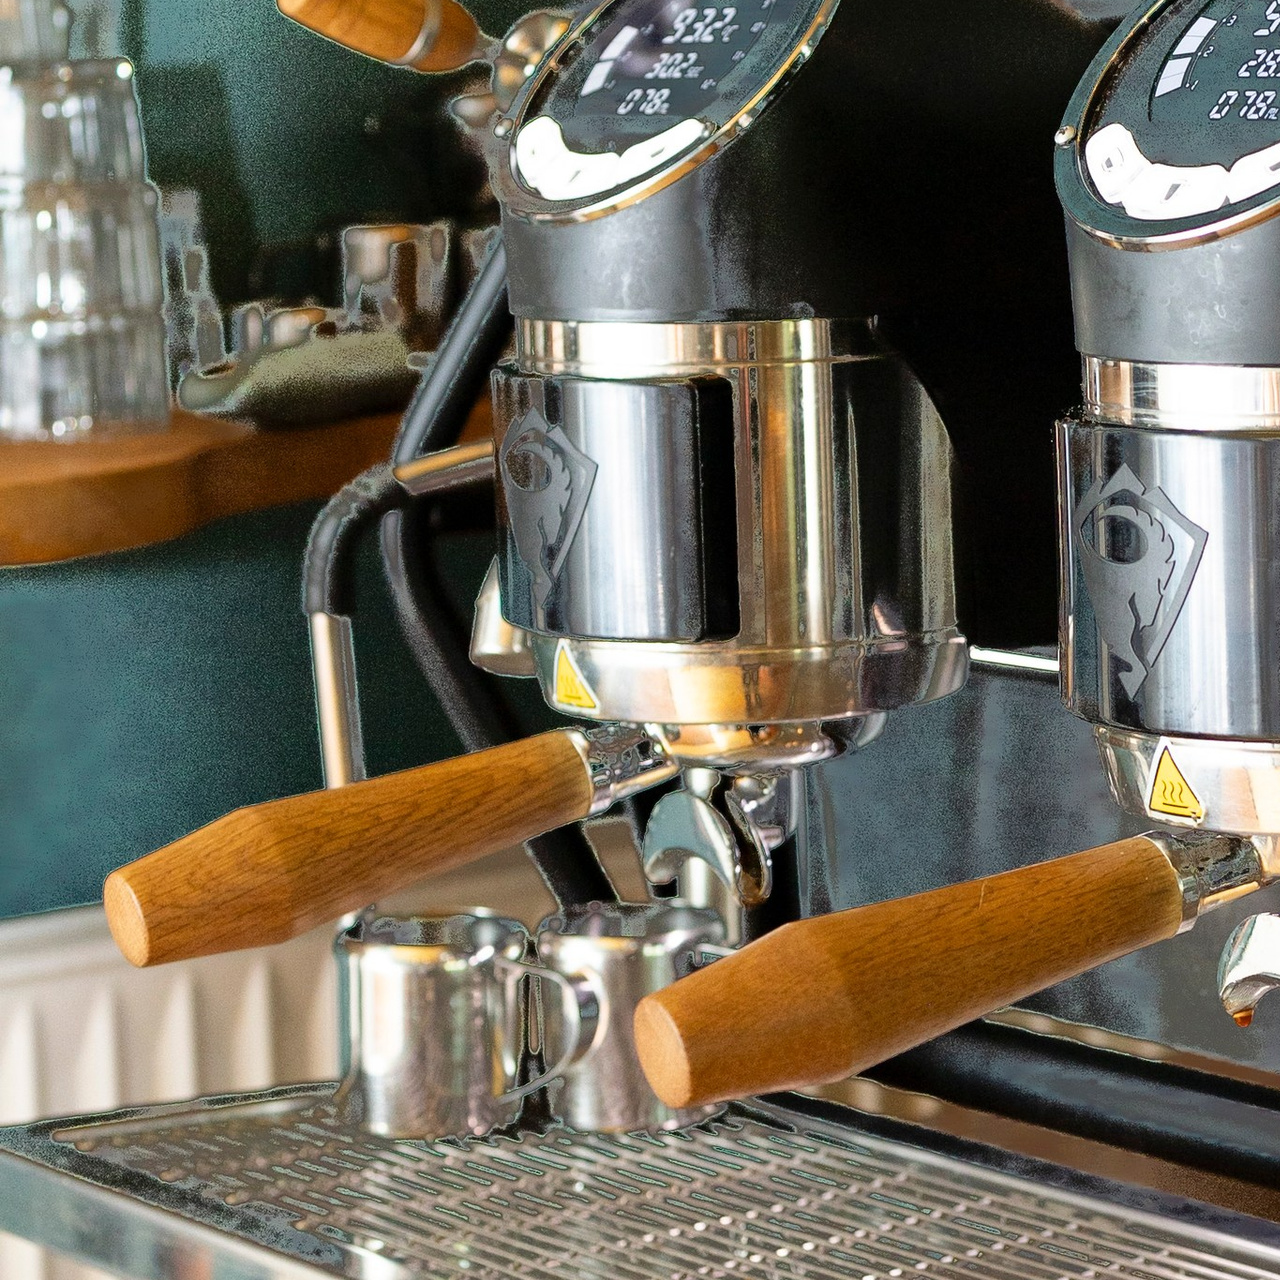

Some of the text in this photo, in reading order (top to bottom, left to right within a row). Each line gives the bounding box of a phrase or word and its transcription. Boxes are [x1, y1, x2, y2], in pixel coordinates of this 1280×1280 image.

[1226, 14, 1238, 26] 3
[1202, 45, 1214, 57] 2
[1190, 79, 1199, 90] 1
